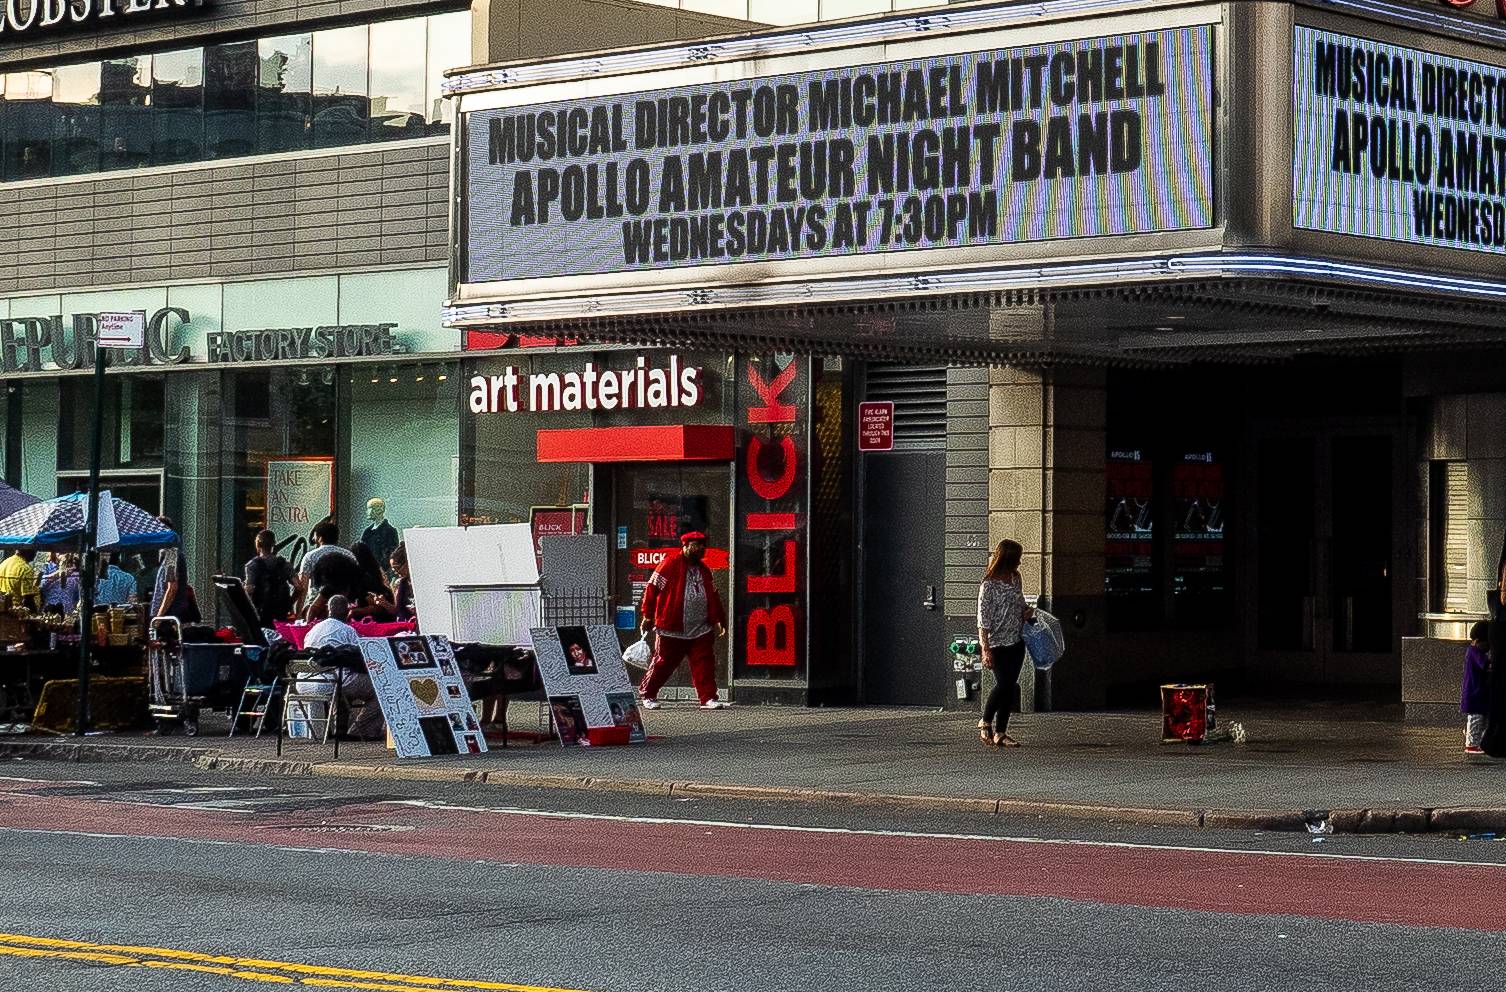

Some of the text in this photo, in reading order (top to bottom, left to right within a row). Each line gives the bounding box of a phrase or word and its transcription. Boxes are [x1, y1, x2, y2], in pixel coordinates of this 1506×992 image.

[488, 41, 1164, 165] MUSICAL DIRECTOR MICHAEL MITCHELL
[1315, 40, 1416, 110] MUSICAL
[510, 111, 1141, 227] APOLLO AMATEUR NIGHT BAND
[1332, 108, 1432, 186] APOLLO
[622, 190, 998, 264] WEDNESDAYS AT 7:30PM
[207, 327, 313, 363] FACTORY
[315, 323, 398, 359] STORE
[470, 354, 698, 413] art materials
[271, 489, 289, 504] AN
[272, 469, 303, 486] TAKE
[271, 506, 309, 523] EXTRA
[746, 358, 798, 665] BLICK
[637, 552, 667, 564] BLICK
